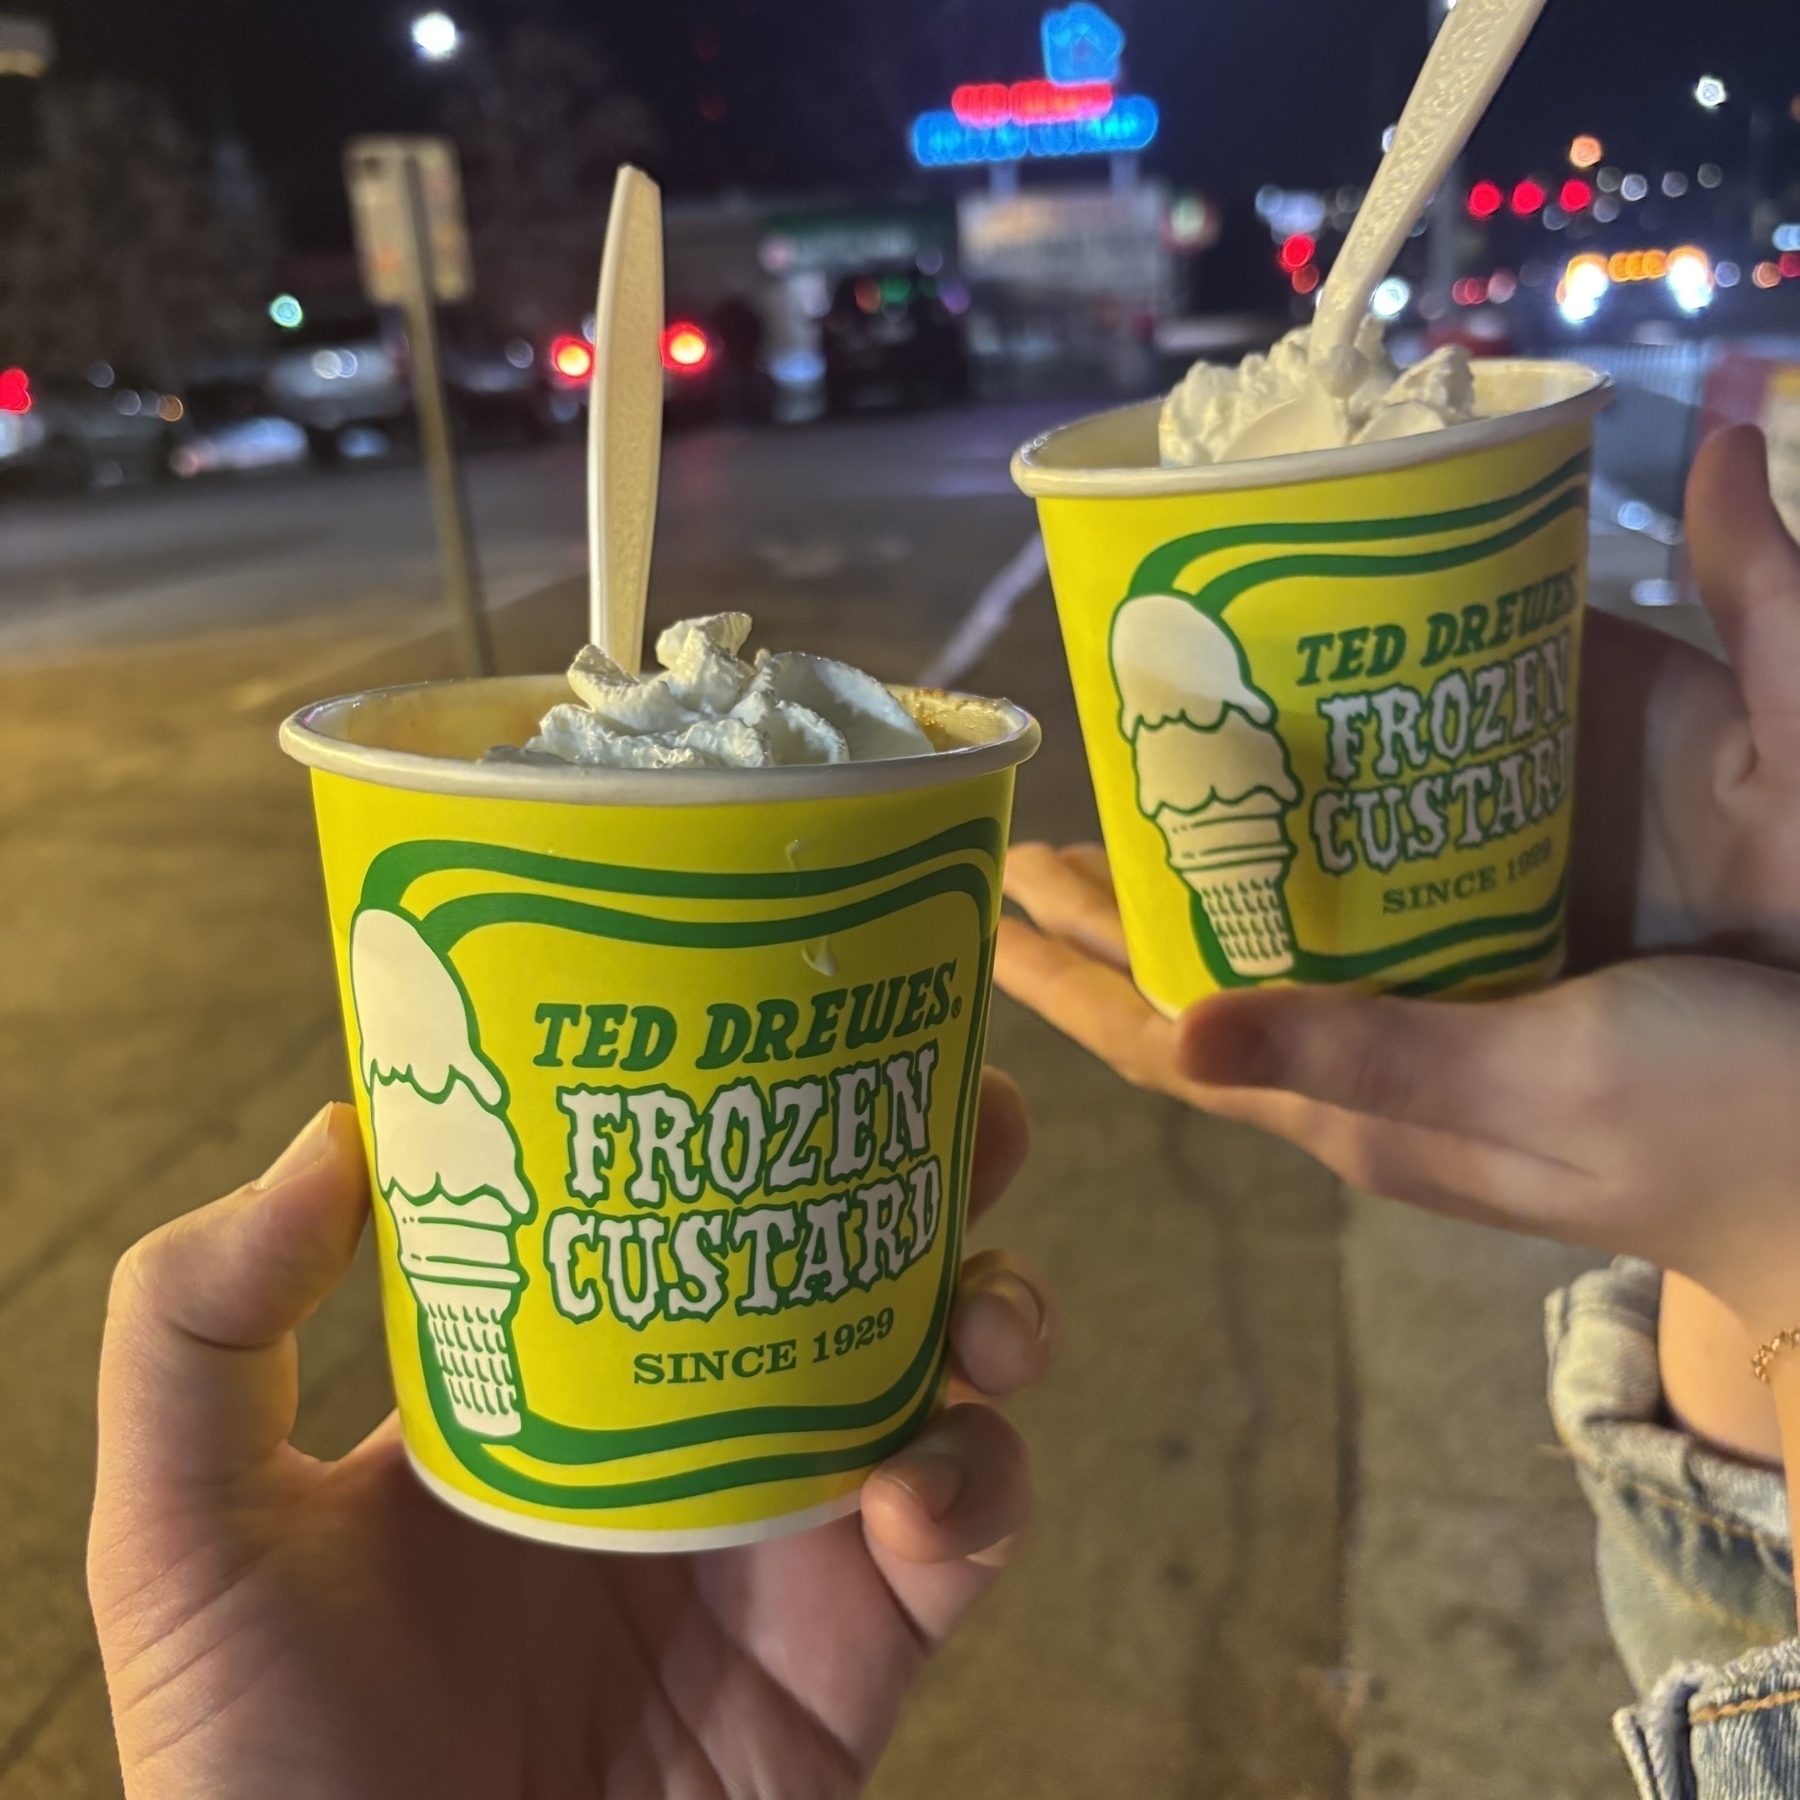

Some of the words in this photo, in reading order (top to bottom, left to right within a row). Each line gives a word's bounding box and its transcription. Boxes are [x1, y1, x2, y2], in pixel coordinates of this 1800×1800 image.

[1296, 624, 1405, 686] TED
[1317, 626, 1570, 782] FROZEN
[1382, 865, 1498, 915] SINCE
[532, 1003, 677, 1071] TED
[556, 1038, 939, 1208] FROZEN
[543, 1154, 942, 1331] CUSTARD
[633, 1339, 797, 1385] SINCE
[812, 1306, 895, 1364] 1929
